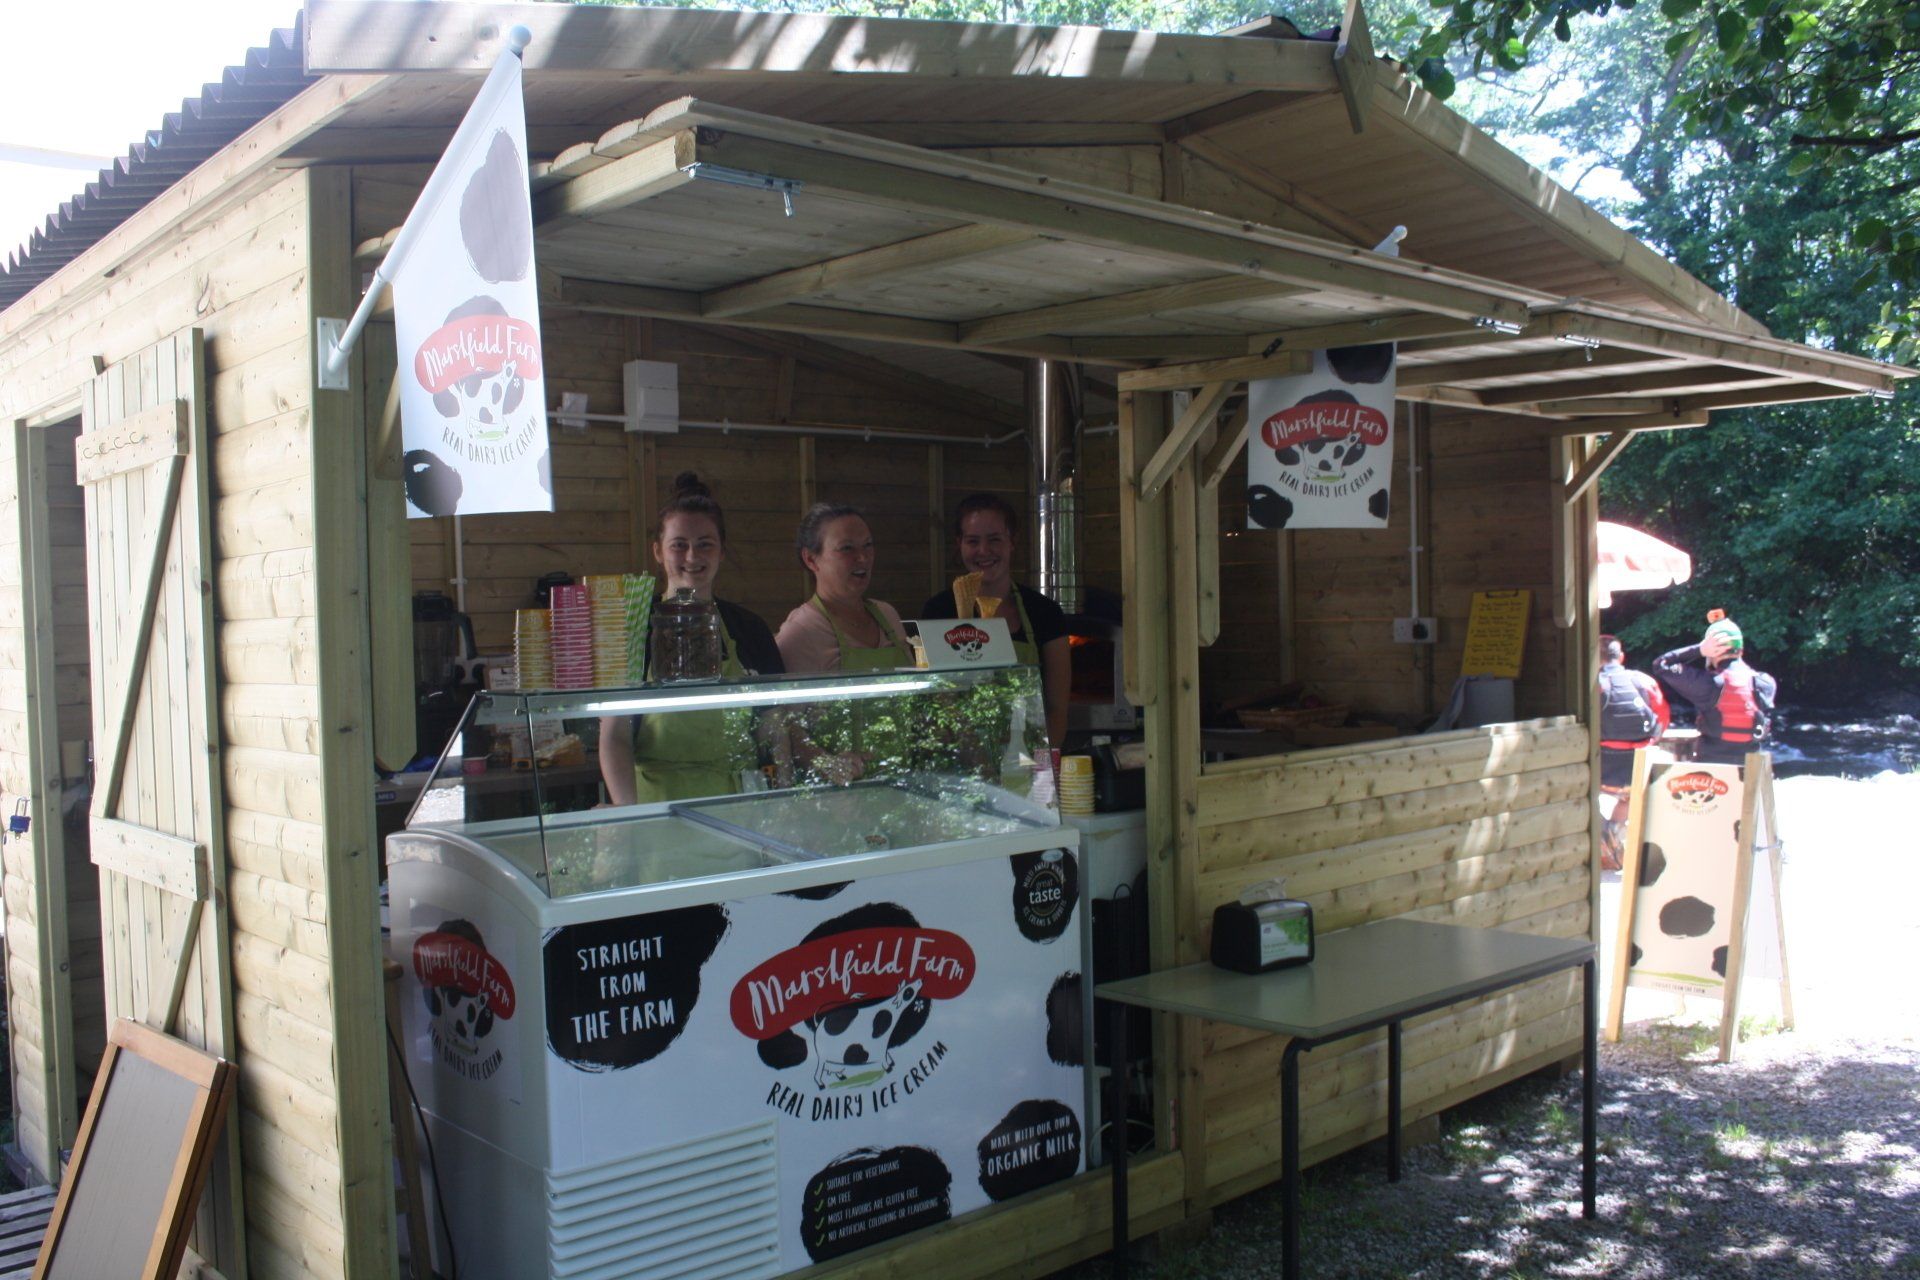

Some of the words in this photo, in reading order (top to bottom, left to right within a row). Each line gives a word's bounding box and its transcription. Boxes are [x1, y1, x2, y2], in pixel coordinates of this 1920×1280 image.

[422, 324, 503, 388] Marshfield
[506, 325, 540, 366] Farm
[441, 426, 465, 456] REAL
[468, 444, 497, 466] DAIRY
[500, 444, 516, 464] ICE
[516, 417, 539, 457] CREAM
[1270, 409, 1351, 446] Marshfield
[1352, 409, 1385, 437] Farm
[1278, 470, 1300, 491] REAL
[1302, 482, 1330, 498] DAIRY
[1334, 482, 1348, 498] ICE
[1350, 467, 1375, 494] CREAM
[1029, 887, 1061, 904] taste
[577, 935, 663, 971] STRAIGHT
[418, 943, 481, 981] Marshfield
[482, 958, 510, 1008] Farm
[600, 970, 646, 999] FROM
[747, 937, 904, 1031] Marshfield
[909, 936, 964, 980] Farm
[570, 1010, 611, 1044] THE
[619, 998, 675, 1035] FARM
[766, 1081, 805, 1119] REAL
[811, 1095, 863, 1122] DAIRY
[872, 1082, 898, 1113] ICE
[903, 1040, 949, 1095] CREAM
[990, 1133, 1010, 1151] MADE
[1014, 1125, 1035, 1144] WITH
[1036, 1120, 1052, 1135] OUR
[1054, 1114, 1071, 1130] OWN
[987, 1141, 1042, 1177] ORGANIC
[1046, 1132, 1076, 1159] MILK
[826, 1173, 851, 1190] SUITABLE
[852, 1169, 863, 1182] FOR
[865, 1159, 901, 1179] VEGETARIANS
[827, 1196, 837, 1207] GM
[838, 1190, 852, 1204] FREE
[827, 1211, 844, 1225] MOST
[845, 1202, 872, 1220] FLAVOURS
[873, 1198, 884, 1210] ARE
[885, 1191, 905, 1207] GLUTEN
[906, 1186, 920, 1200] FREE
[828, 1230, 838, 1242] NO
[838, 1221, 867, 1239] ARTIFICIAL
[868, 1210, 898, 1228] COLOURING
[898, 1206, 907, 1218] OR
[907, 1196, 939, 1216] FLAVOURING
